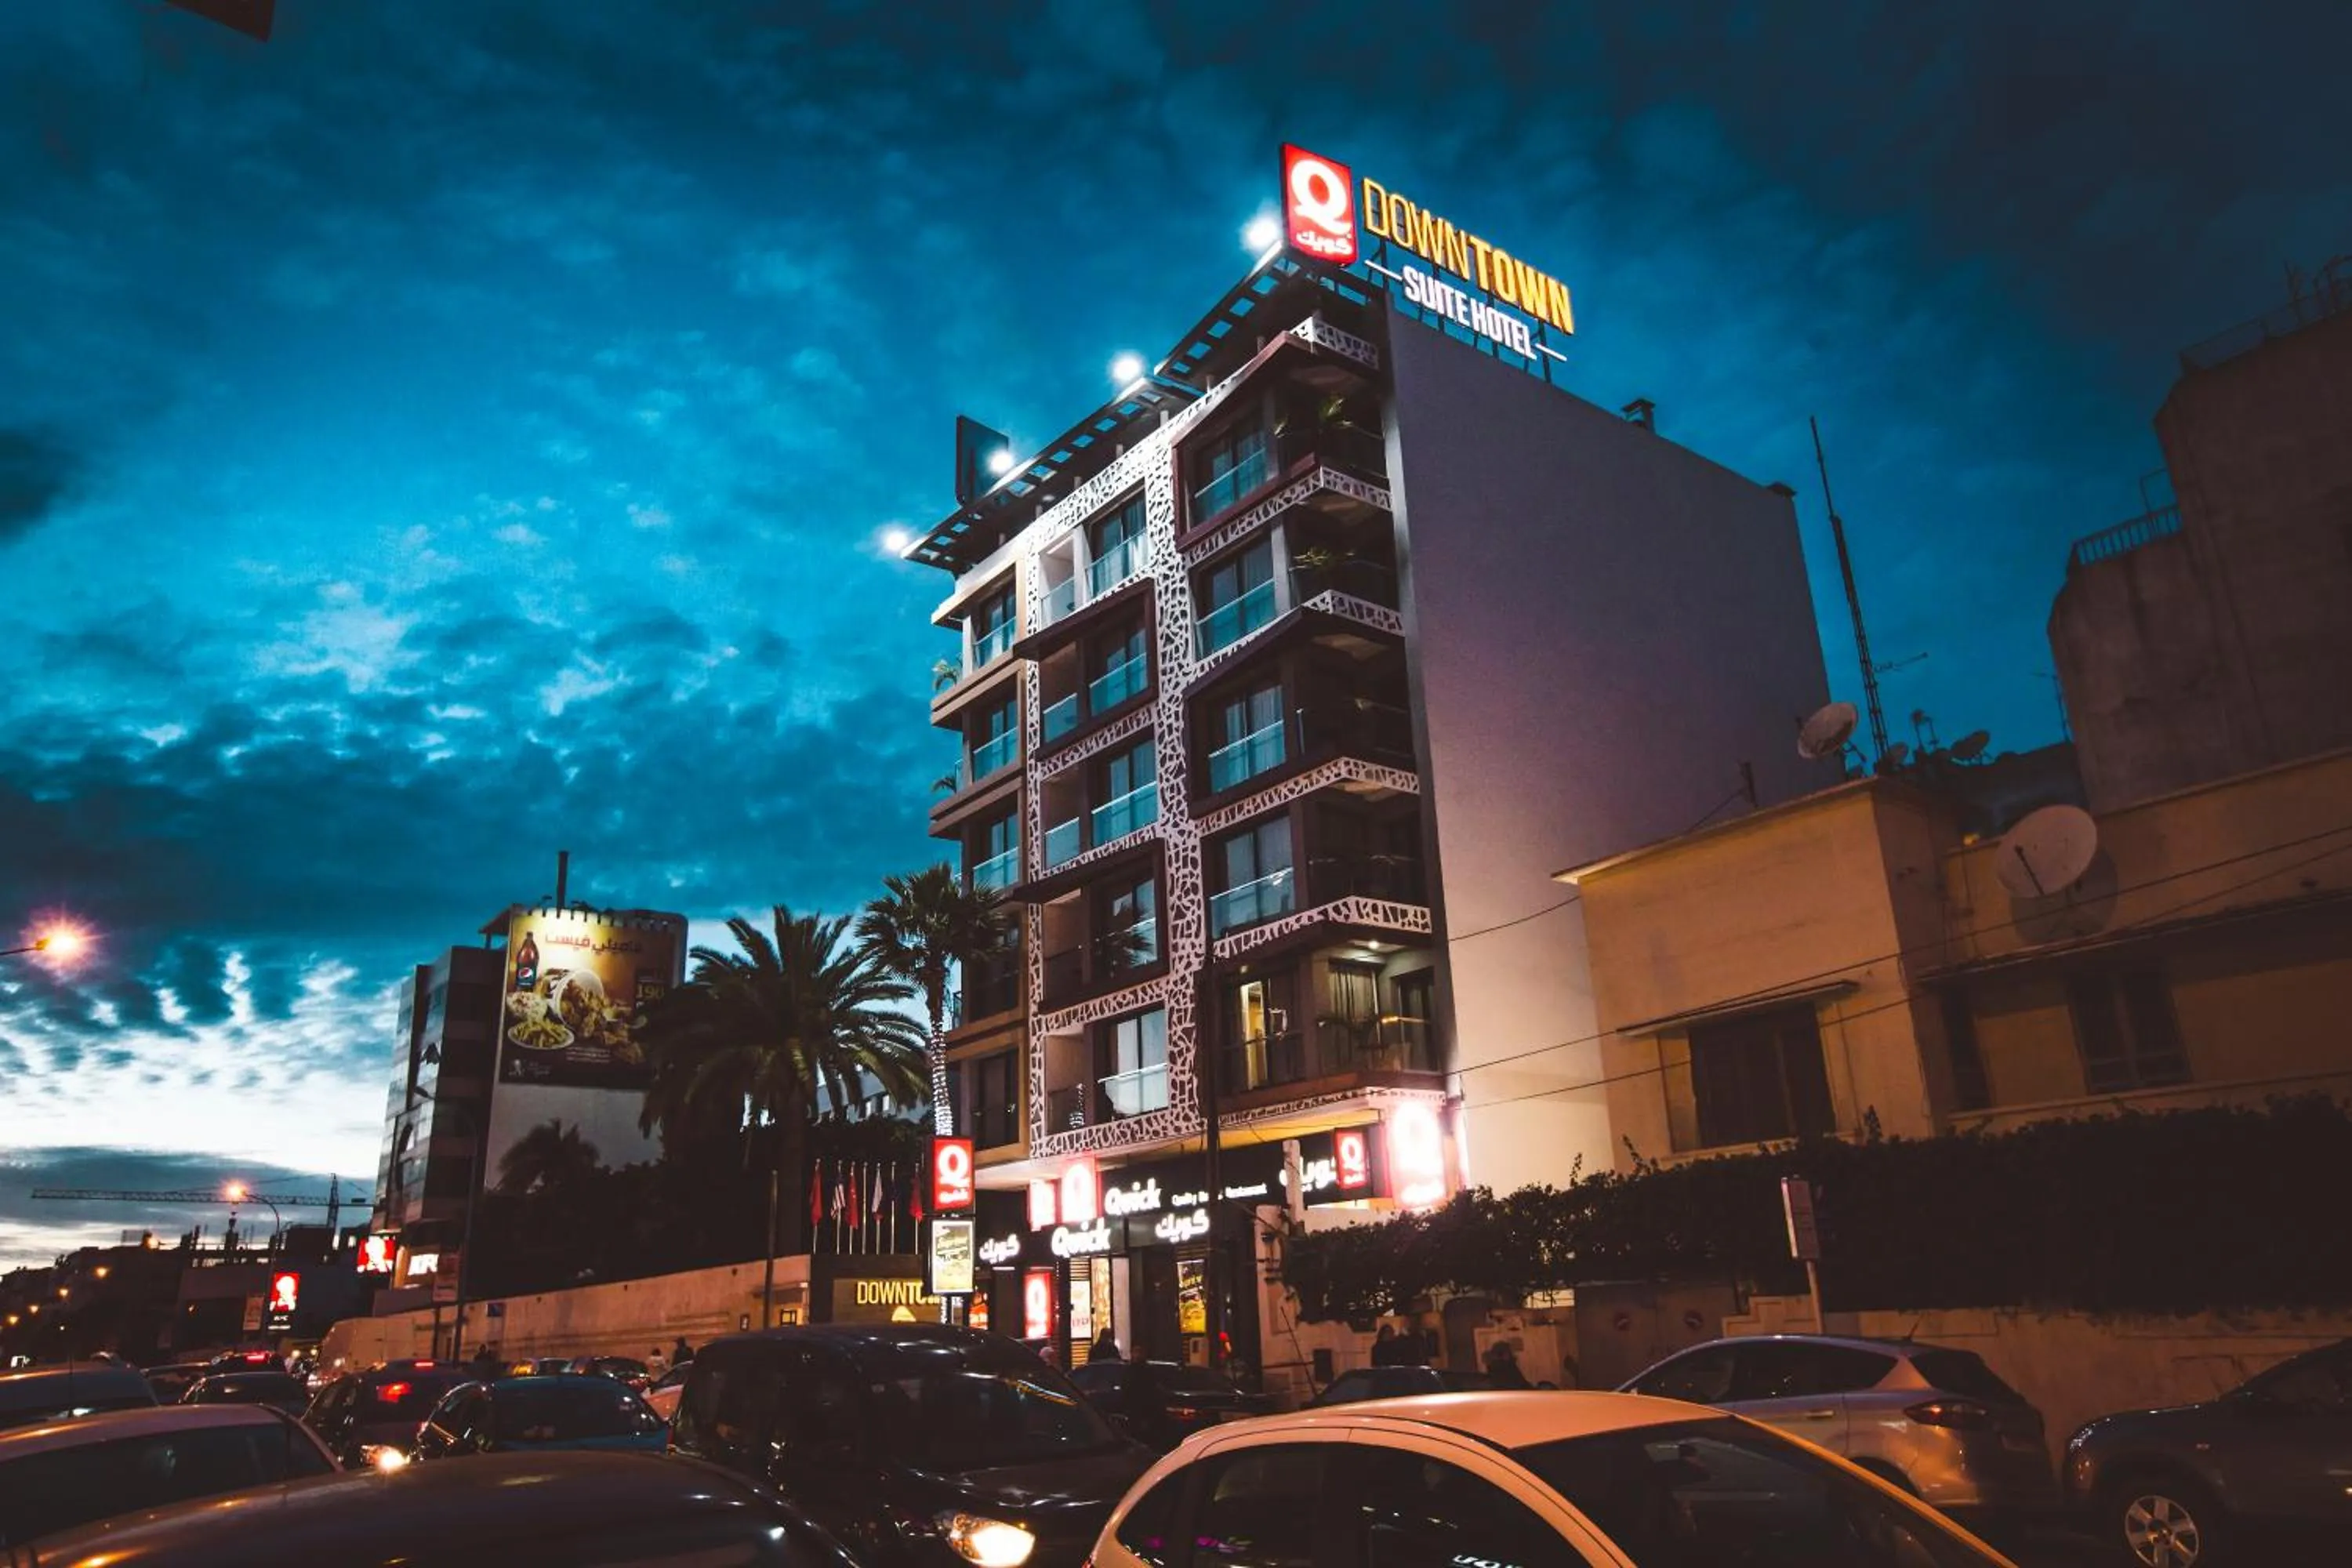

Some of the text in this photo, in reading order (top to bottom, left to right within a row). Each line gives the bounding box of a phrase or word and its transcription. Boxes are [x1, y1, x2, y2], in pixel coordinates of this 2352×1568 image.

[1291, 159, 1352, 236] Q
[1296, 230, 1353, 256] كويك
[1402, 264, 1537, 361] SUITE HOTEL
[937, 1145, 971, 1189] Q
[1105, 1178, 1162, 1215] Quick
[1051, 1217, 1111, 1258] Quick
[1155, 1208, 1210, 1244] كويك
[979, 1233, 1020, 1265] كويك
